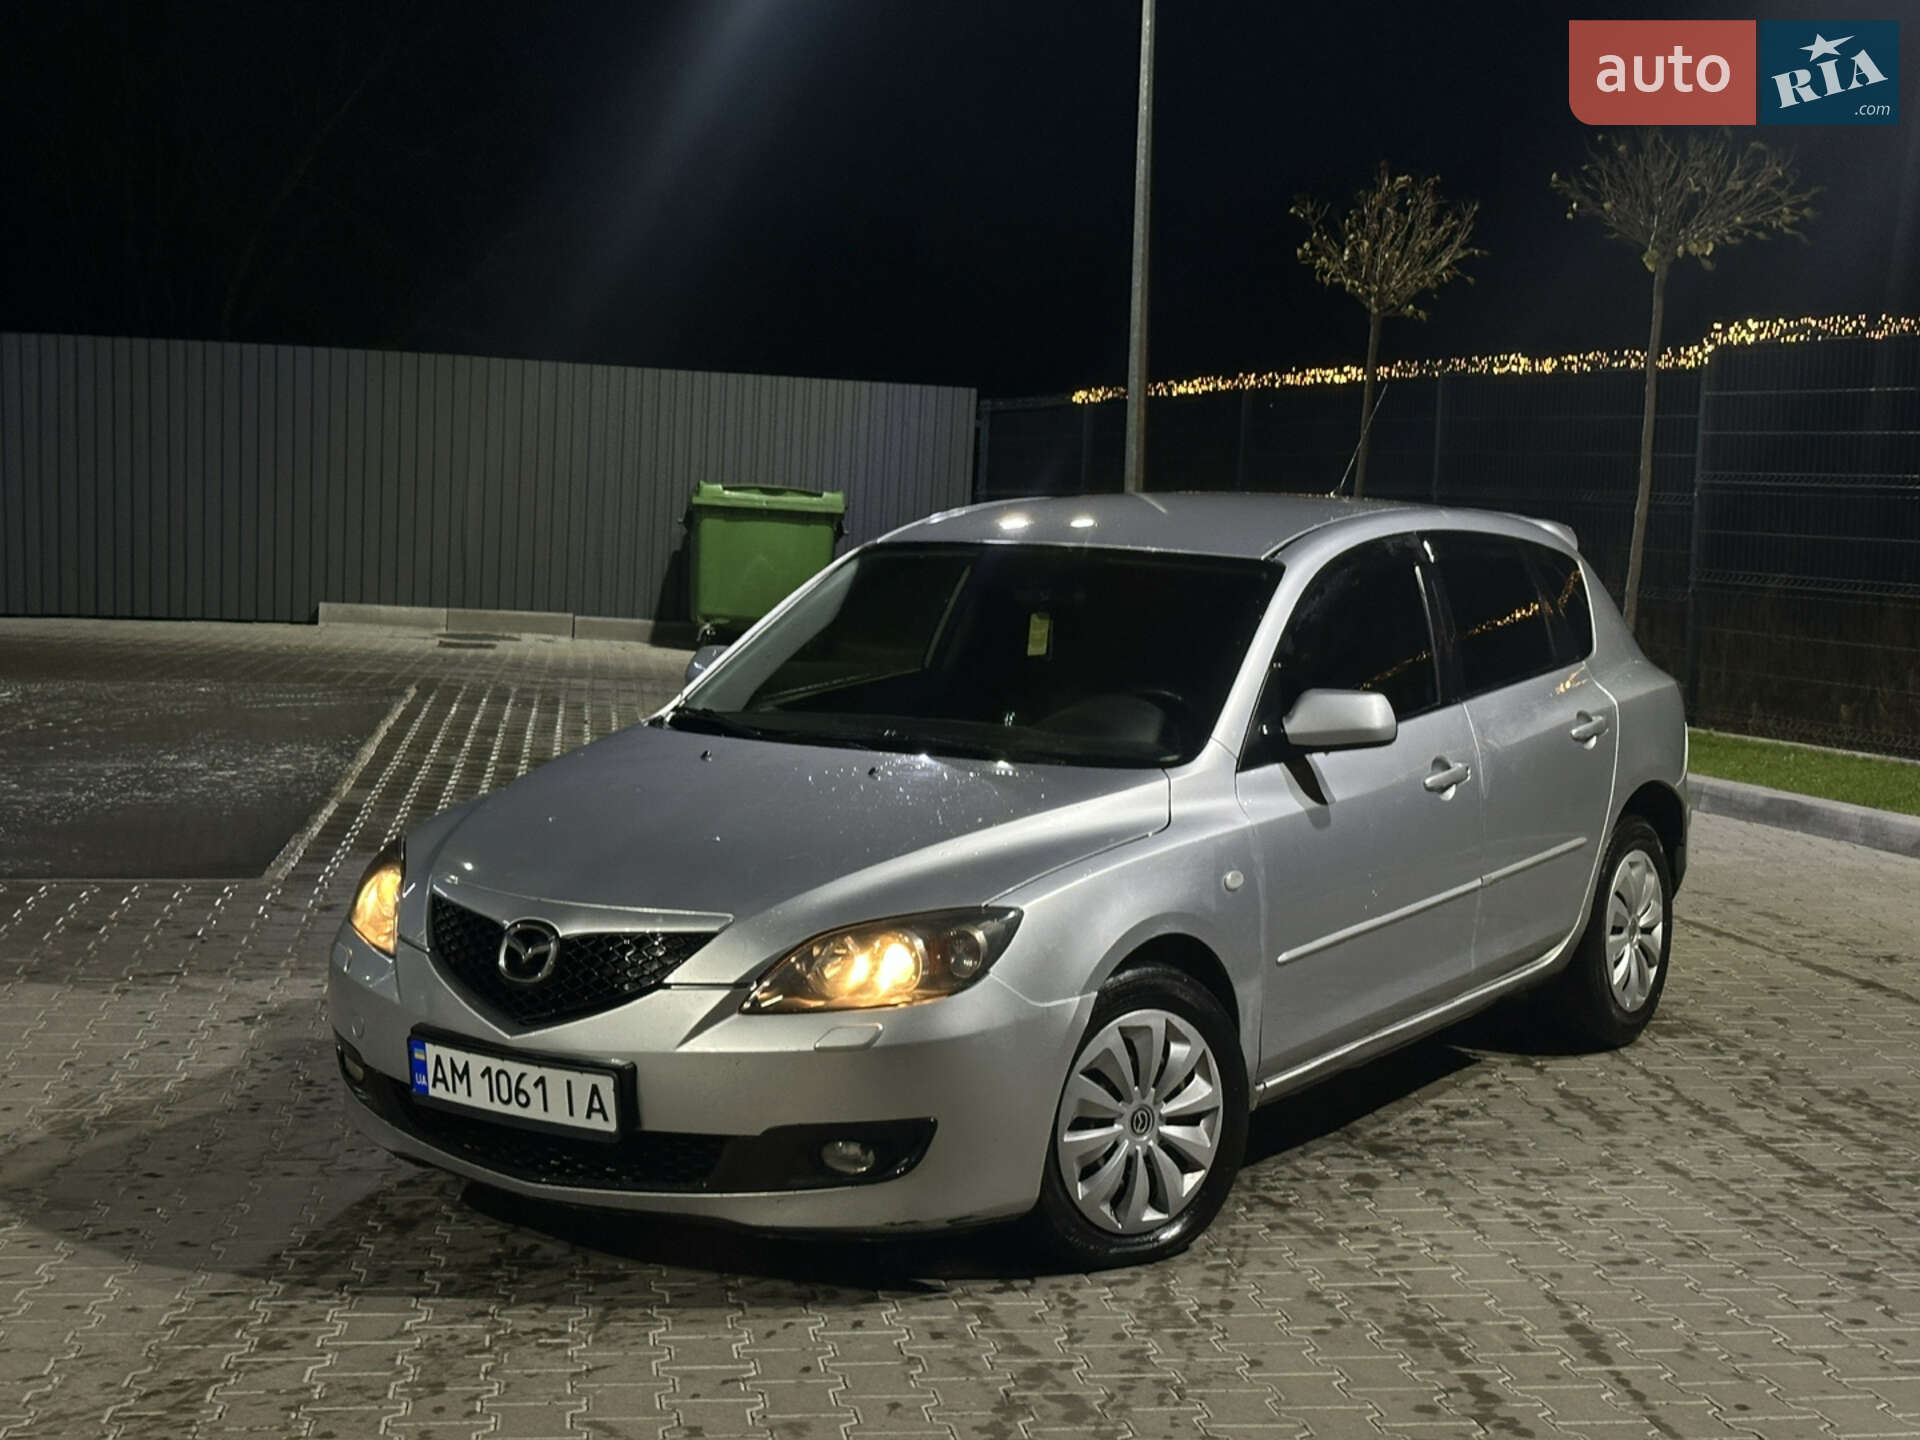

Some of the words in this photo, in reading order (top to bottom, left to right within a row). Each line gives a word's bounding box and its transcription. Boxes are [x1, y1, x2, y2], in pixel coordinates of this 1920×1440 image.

[414, 1073, 428, 1087] UA
[431, 1054, 472, 1098] AM
[480, 1066, 549, 1113] 1061
